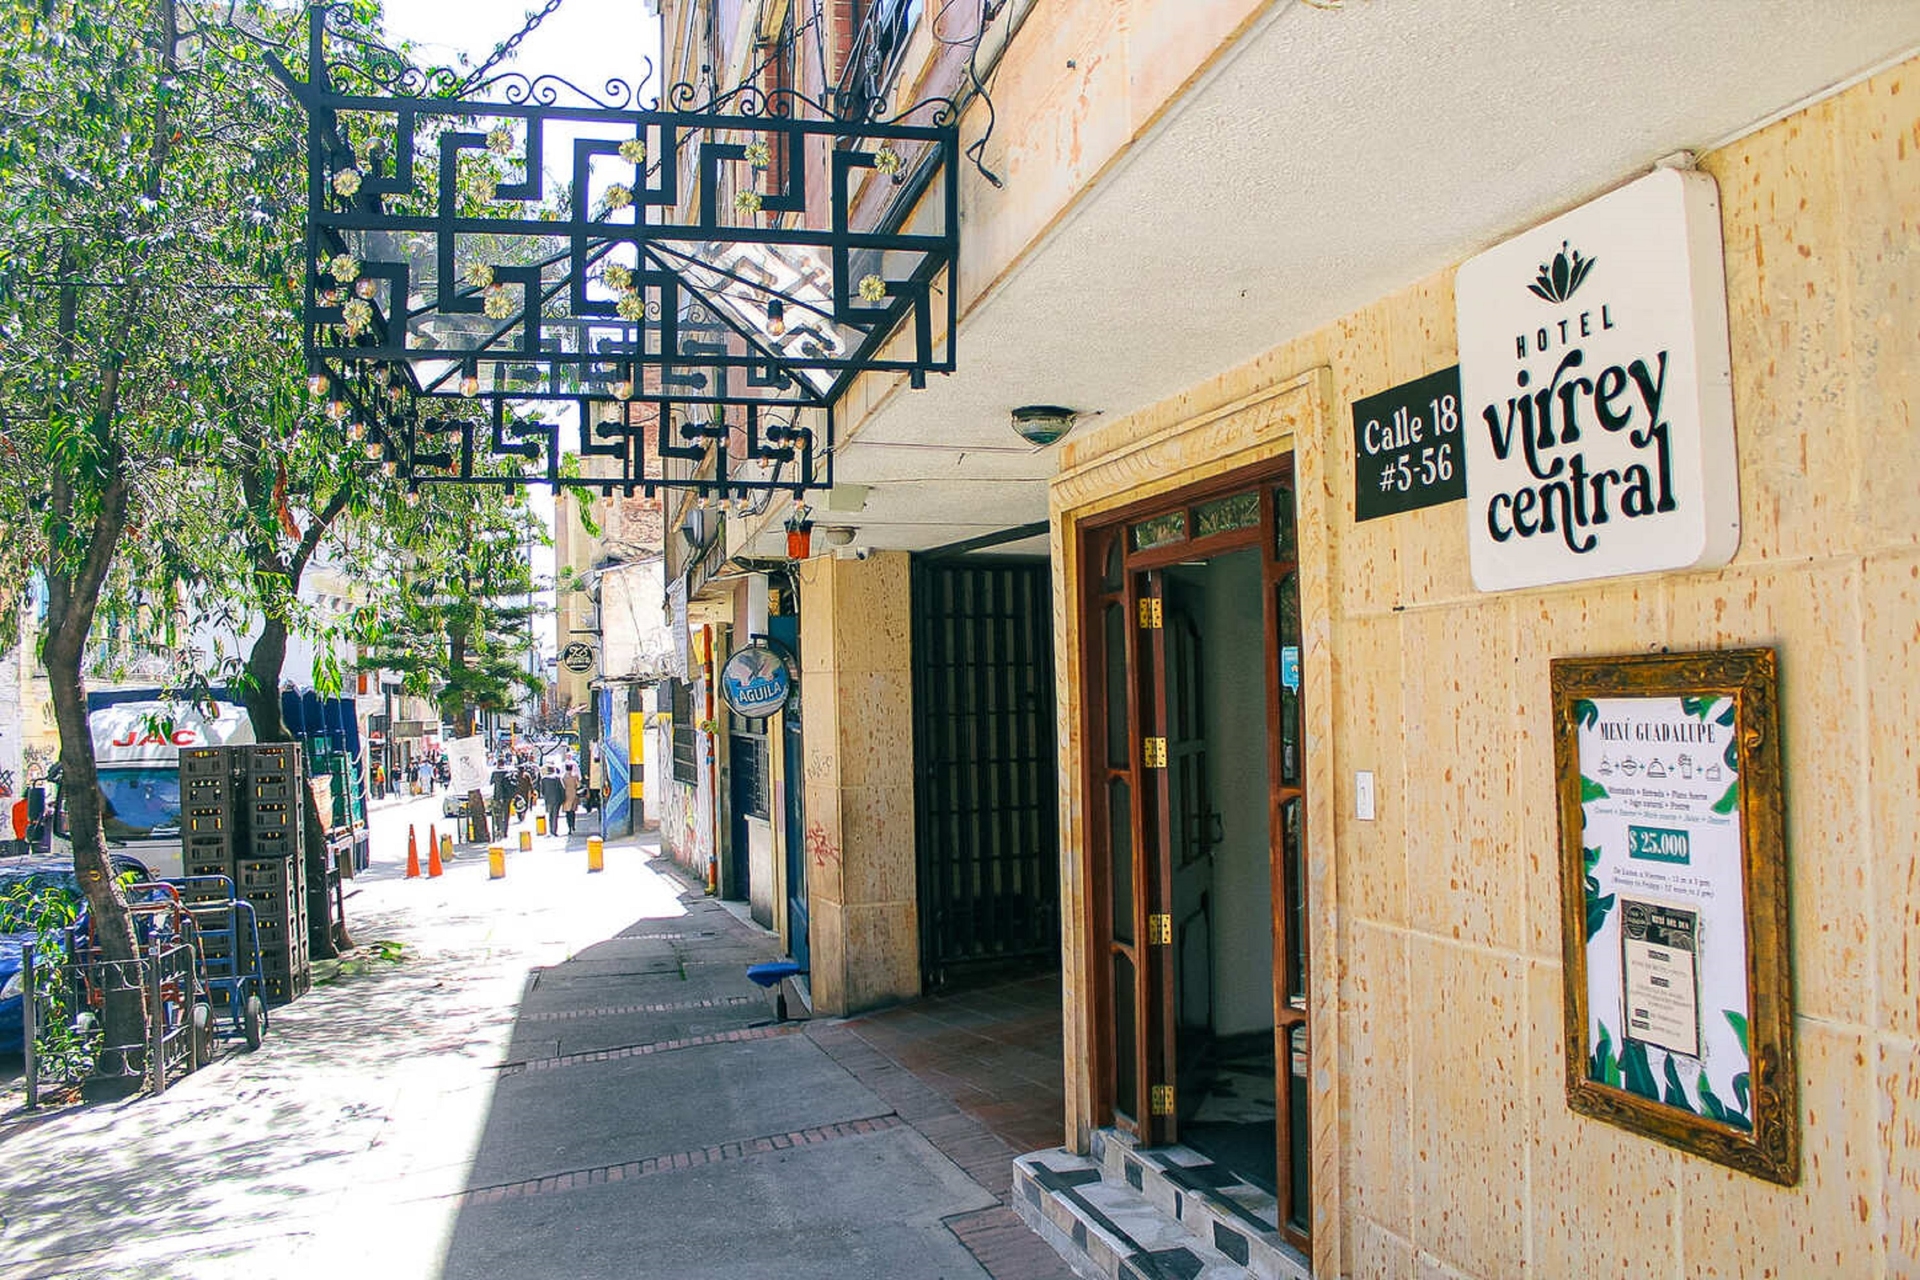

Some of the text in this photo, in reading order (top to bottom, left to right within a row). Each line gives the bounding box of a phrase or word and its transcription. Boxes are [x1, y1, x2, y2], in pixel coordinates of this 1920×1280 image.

[1516, 305, 1613, 359] HOTEL
[1364, 395, 1458, 455] Calle 18
[1483, 349, 1668, 480] virrey
[1380, 444, 1453, 491] #5-56
[1487, 421, 1676, 554] central
[740, 682, 781, 702] AGUILA
[113, 730, 196, 747] JAC
[1600, 717, 1715, 743] MENÚ GUADALUPE
[1630, 830, 1687, 857] $ 25.000
